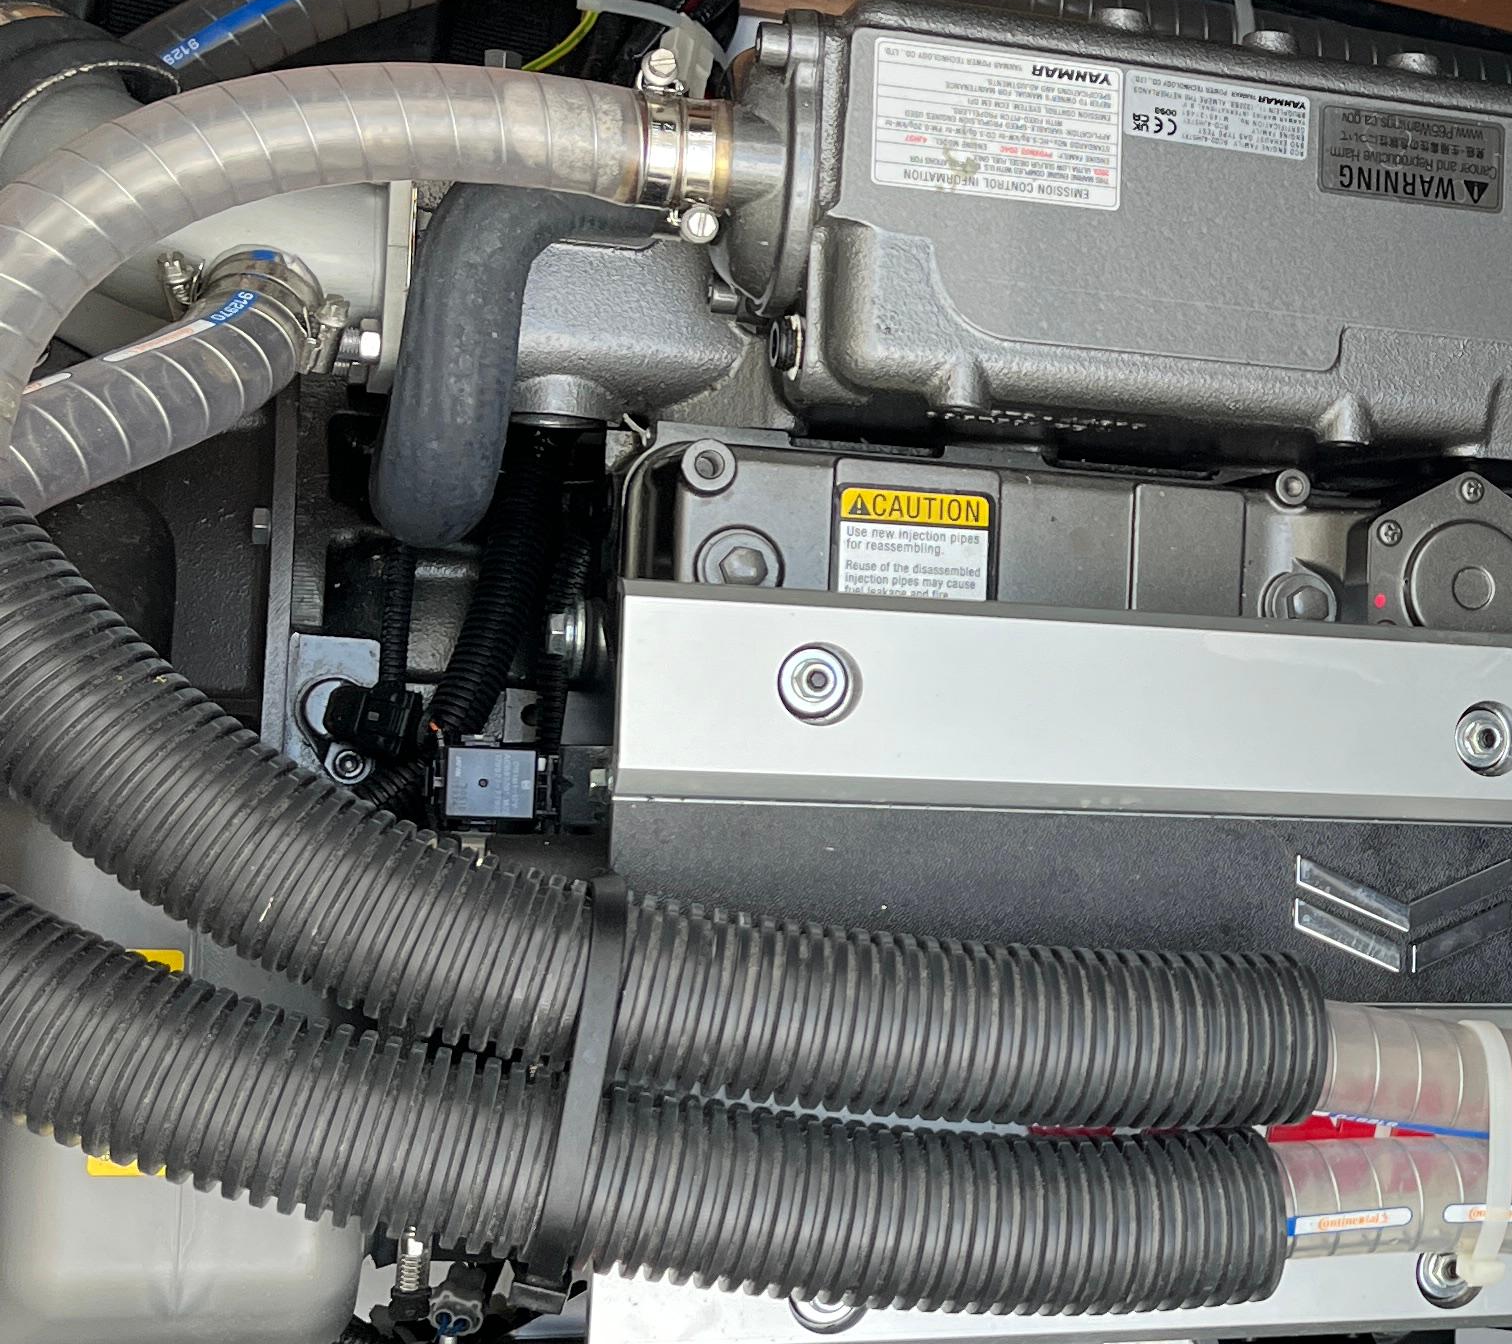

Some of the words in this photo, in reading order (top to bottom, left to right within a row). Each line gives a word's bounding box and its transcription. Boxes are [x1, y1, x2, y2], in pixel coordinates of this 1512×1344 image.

[160, 36, 201, 67] 9129
[1031, 64, 1112, 85] YANMAR
[1257, 95, 1305, 109] YANMAR
[1329, 146, 1360, 161] Harm
[1362, 149, 1433, 170] Reproductive
[1436, 160, 1456, 174] and
[1459, 162, 1497, 179] Cancer
[903, 168, 978, 185] INFORMATION
[982, 177, 1033, 192] CONTROL
[1337, 163, 1457, 200] WARNING
[1037, 183, 1089, 198] EMISSION
[872, 494, 980, 522] CAUTION
[846, 526, 867, 537] Use
[871, 529, 894, 539] new
[898, 528, 946, 543] injection
[950, 532, 979, 545] pipes
[846, 539, 862, 549] for
[865, 540, 944, 556] reassembling.
[845, 559, 876, 571] Reuse
[880, 561, 890, 572] of
[893, 562, 909, 573] the
[912, 564, 980, 577] disassembled
[844, 573, 888, 586] injection
[891, 576, 919, 588] pipes
[922, 579, 943, 590] may
[946, 579, 976, 589] cause
